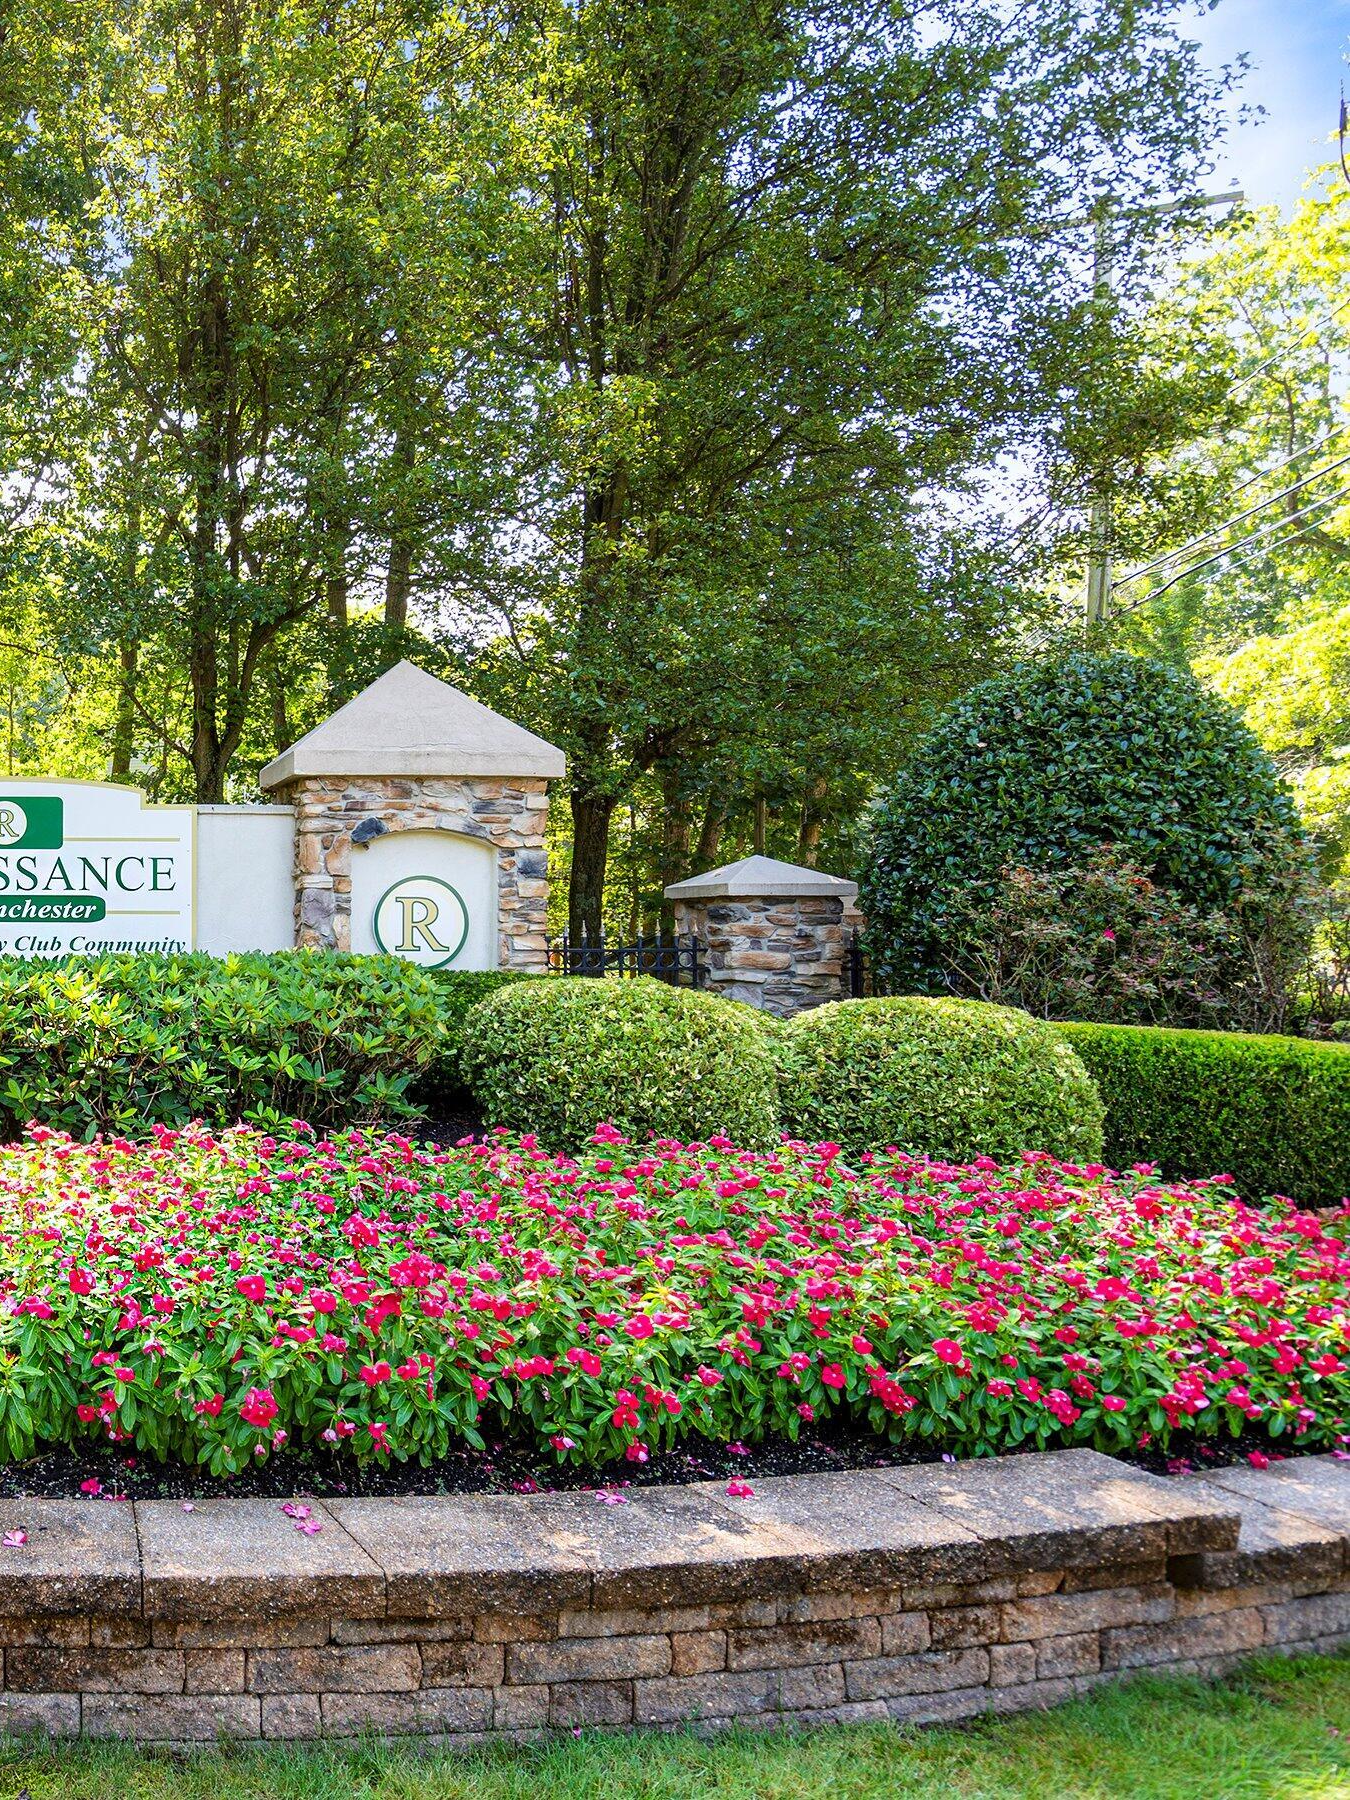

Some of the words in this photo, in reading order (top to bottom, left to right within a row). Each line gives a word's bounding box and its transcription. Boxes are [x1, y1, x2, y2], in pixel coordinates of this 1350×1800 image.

[395, 896, 450, 952] R
[14, 935, 62, 952] Club
[69, 935, 187, 954] Community
